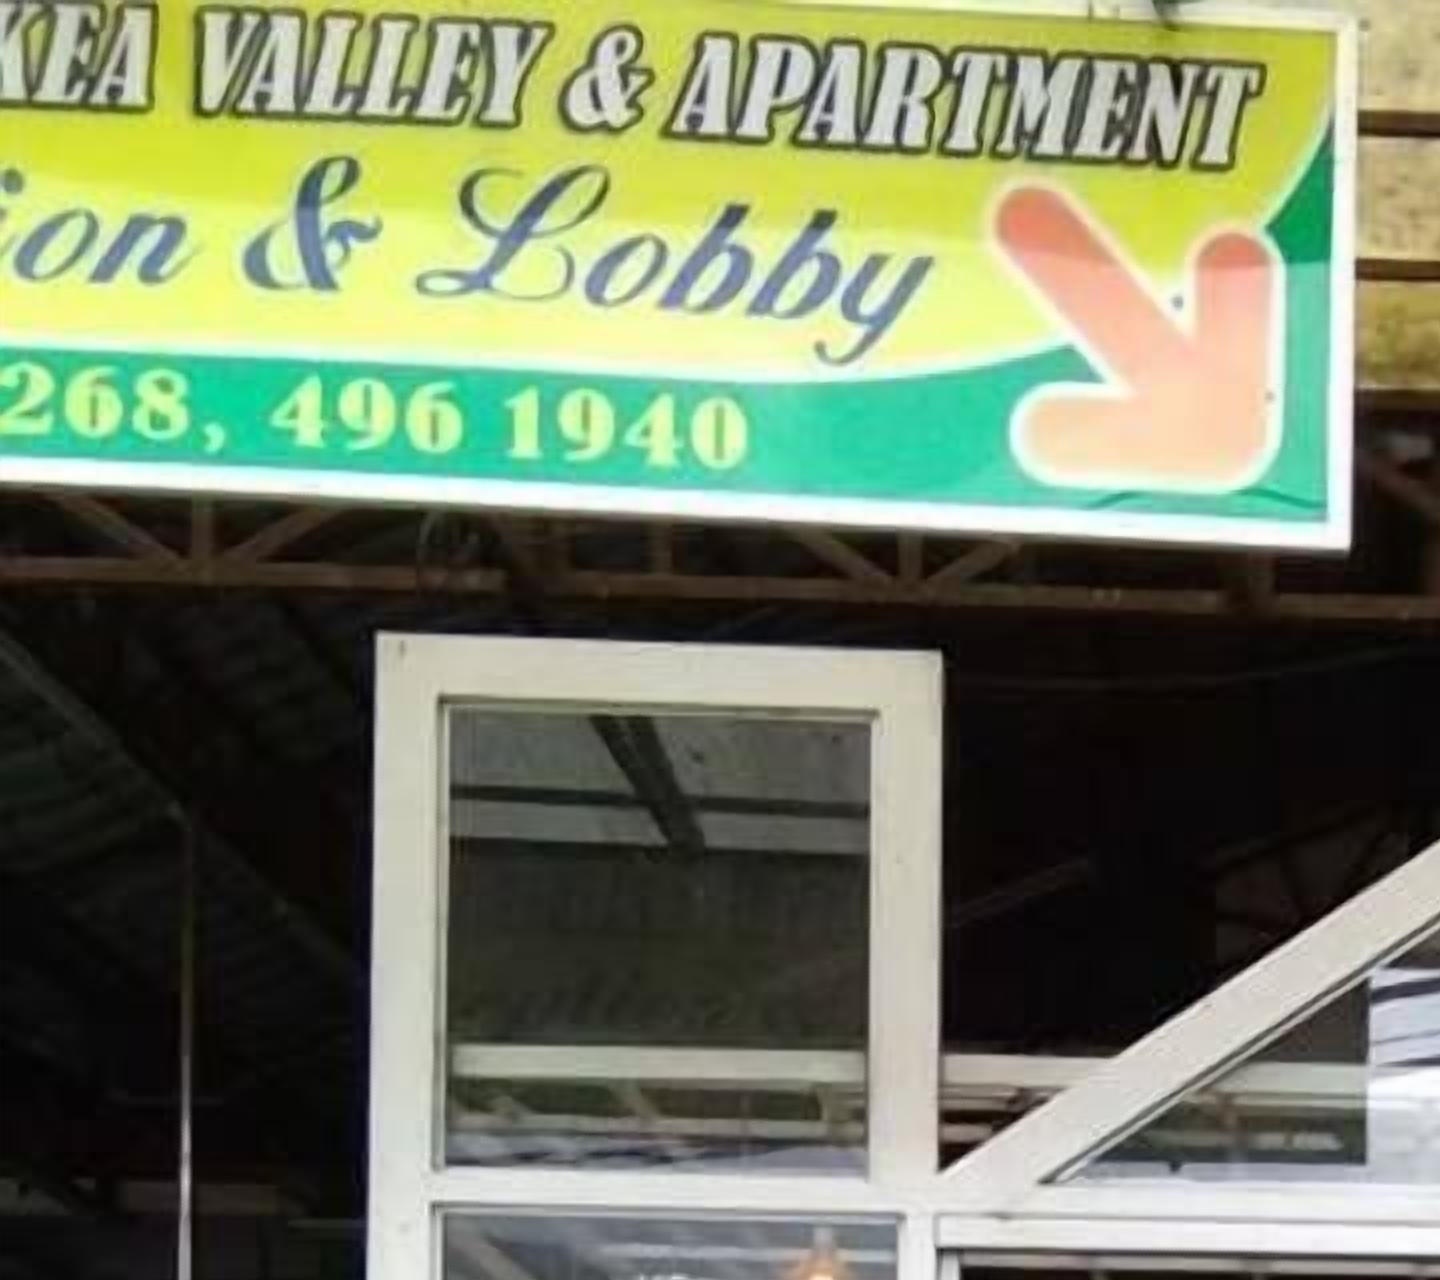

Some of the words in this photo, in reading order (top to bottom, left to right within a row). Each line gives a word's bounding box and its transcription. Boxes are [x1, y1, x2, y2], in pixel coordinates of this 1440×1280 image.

[195, 4, 555, 129] VALLEY
[558, 25, 655, 133] &
[663, 32, 1266, 172] APARTMENT
[243, 156, 383, 293] &
[415, 165, 935, 365] Lobby
[0, 362, 227, 455] 268,
[269, 377, 463, 453] 496
[505, 385, 748, 471] 1940
